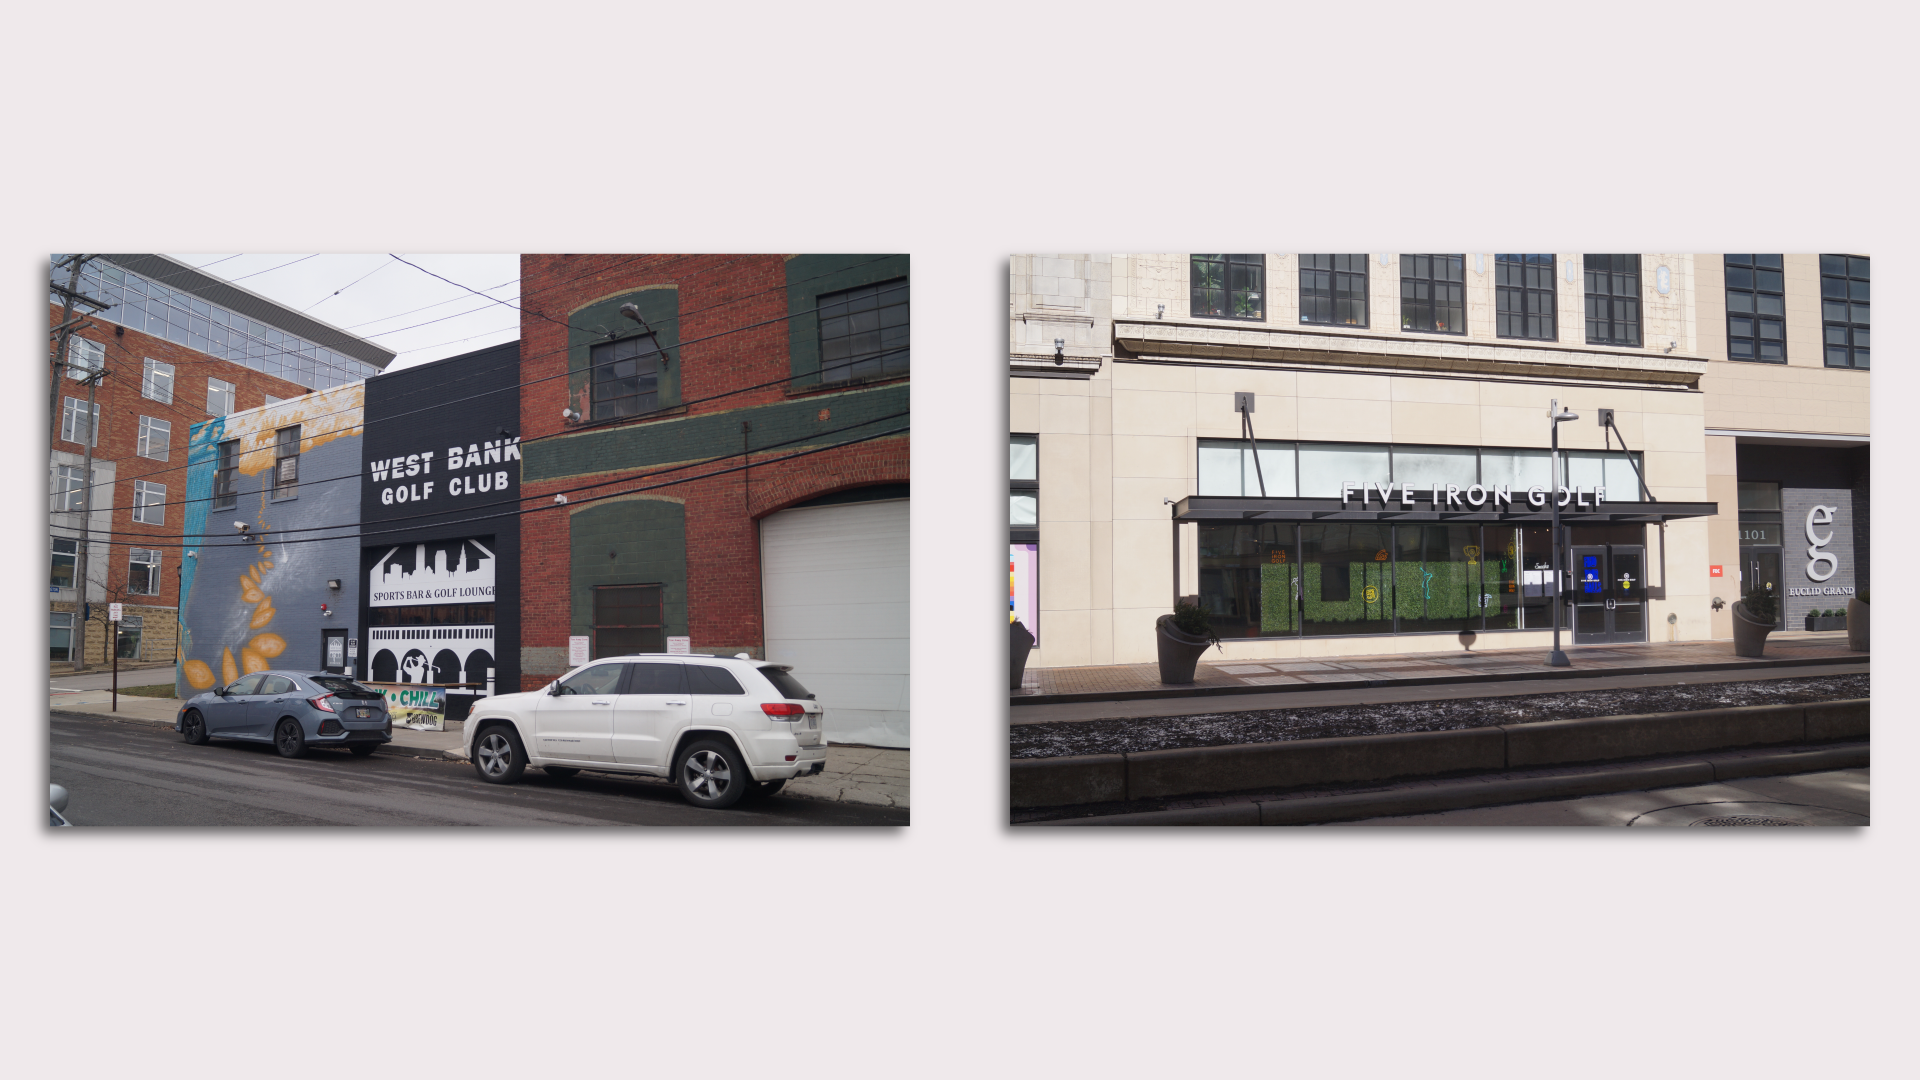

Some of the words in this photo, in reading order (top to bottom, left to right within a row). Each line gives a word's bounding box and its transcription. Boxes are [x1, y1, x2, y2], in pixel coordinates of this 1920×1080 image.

[370, 451, 434, 482] WEST
[448, 436, 521, 470] BANK
[381, 482, 434, 506] GOLF
[449, 471, 509, 496] CLUB
[1342, 481, 1416, 504] FIVE
[1433, 483, 1512, 506] IRON
[1528, 485, 1606, 507] GOLF
[374, 590, 404, 601] SPORTS
[406, 590, 423, 600] BAR
[425, 590, 432, 598] &
[434, 588, 458, 598] GOLF
[1789, 587, 1821, 596] EUCLID
[1823, 586, 1855, 596] GRAND
[400, 690, 439, 708] CHILL
